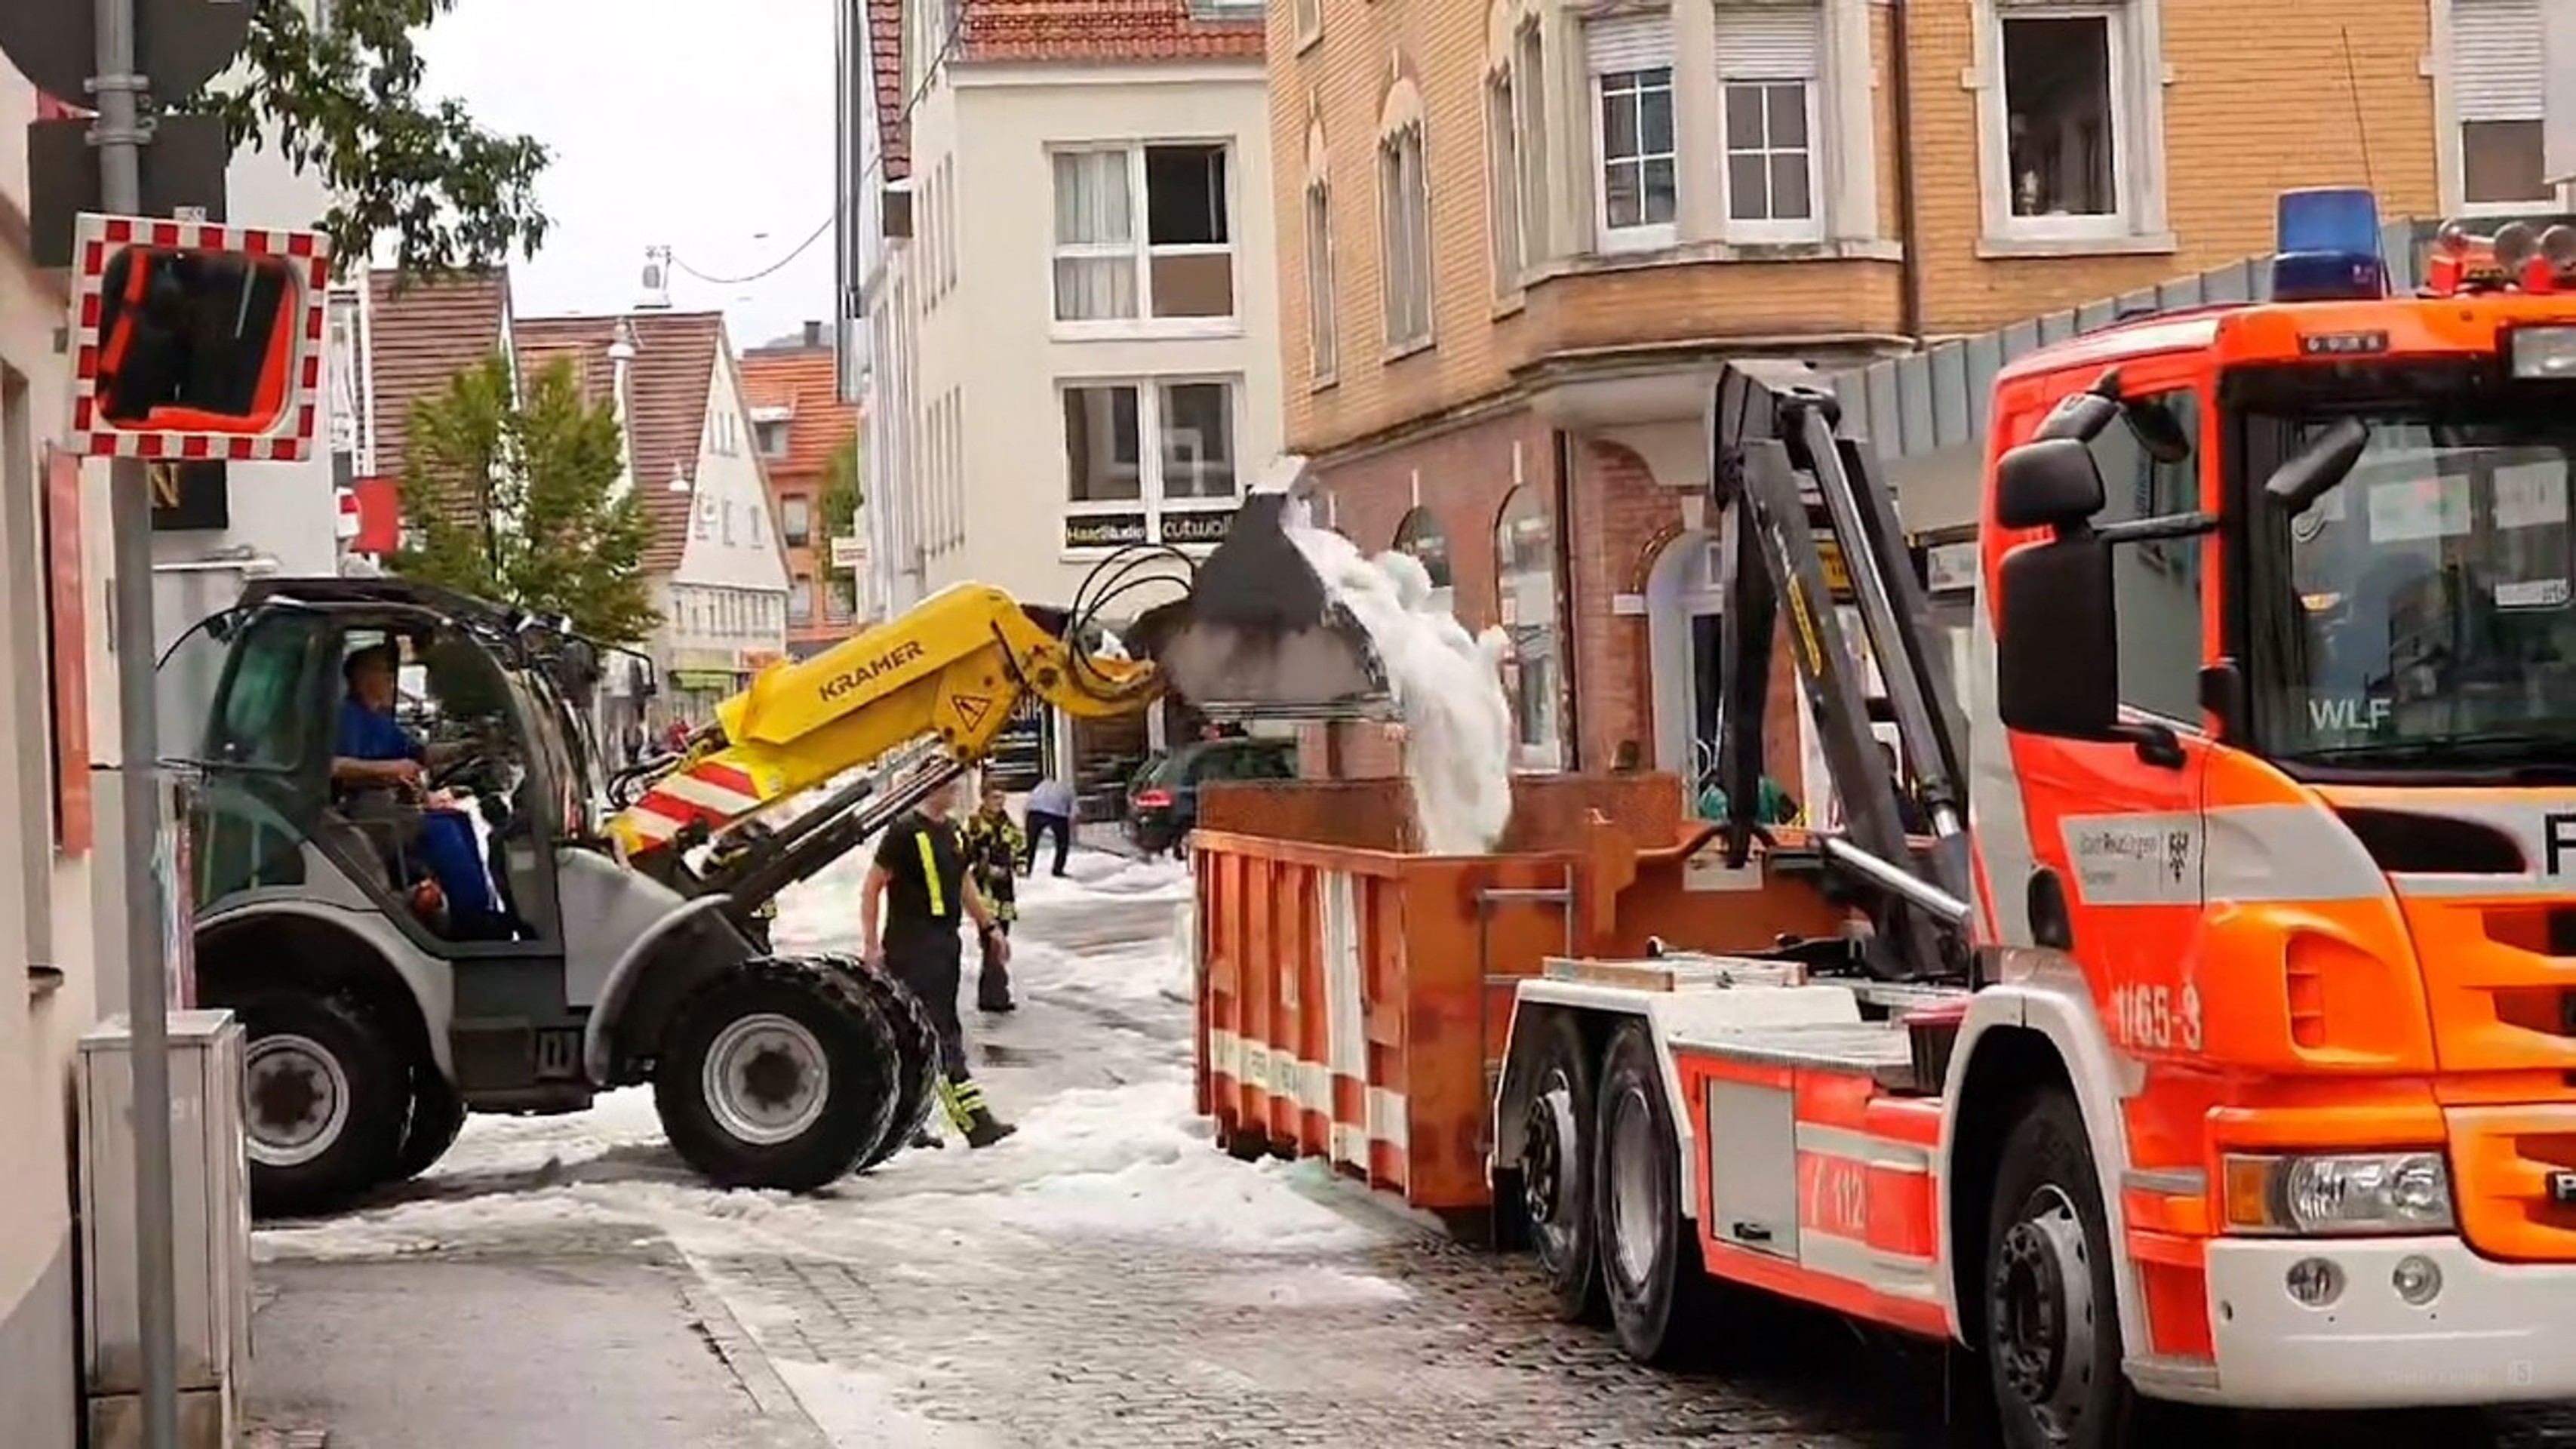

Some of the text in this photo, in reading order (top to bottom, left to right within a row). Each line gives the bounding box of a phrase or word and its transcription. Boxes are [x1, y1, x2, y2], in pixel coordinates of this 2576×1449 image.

[819, 641, 924, 702] KRAMER
[2309, 698, 2392, 731] WLF
[1833, 1169, 1864, 1228] 112
